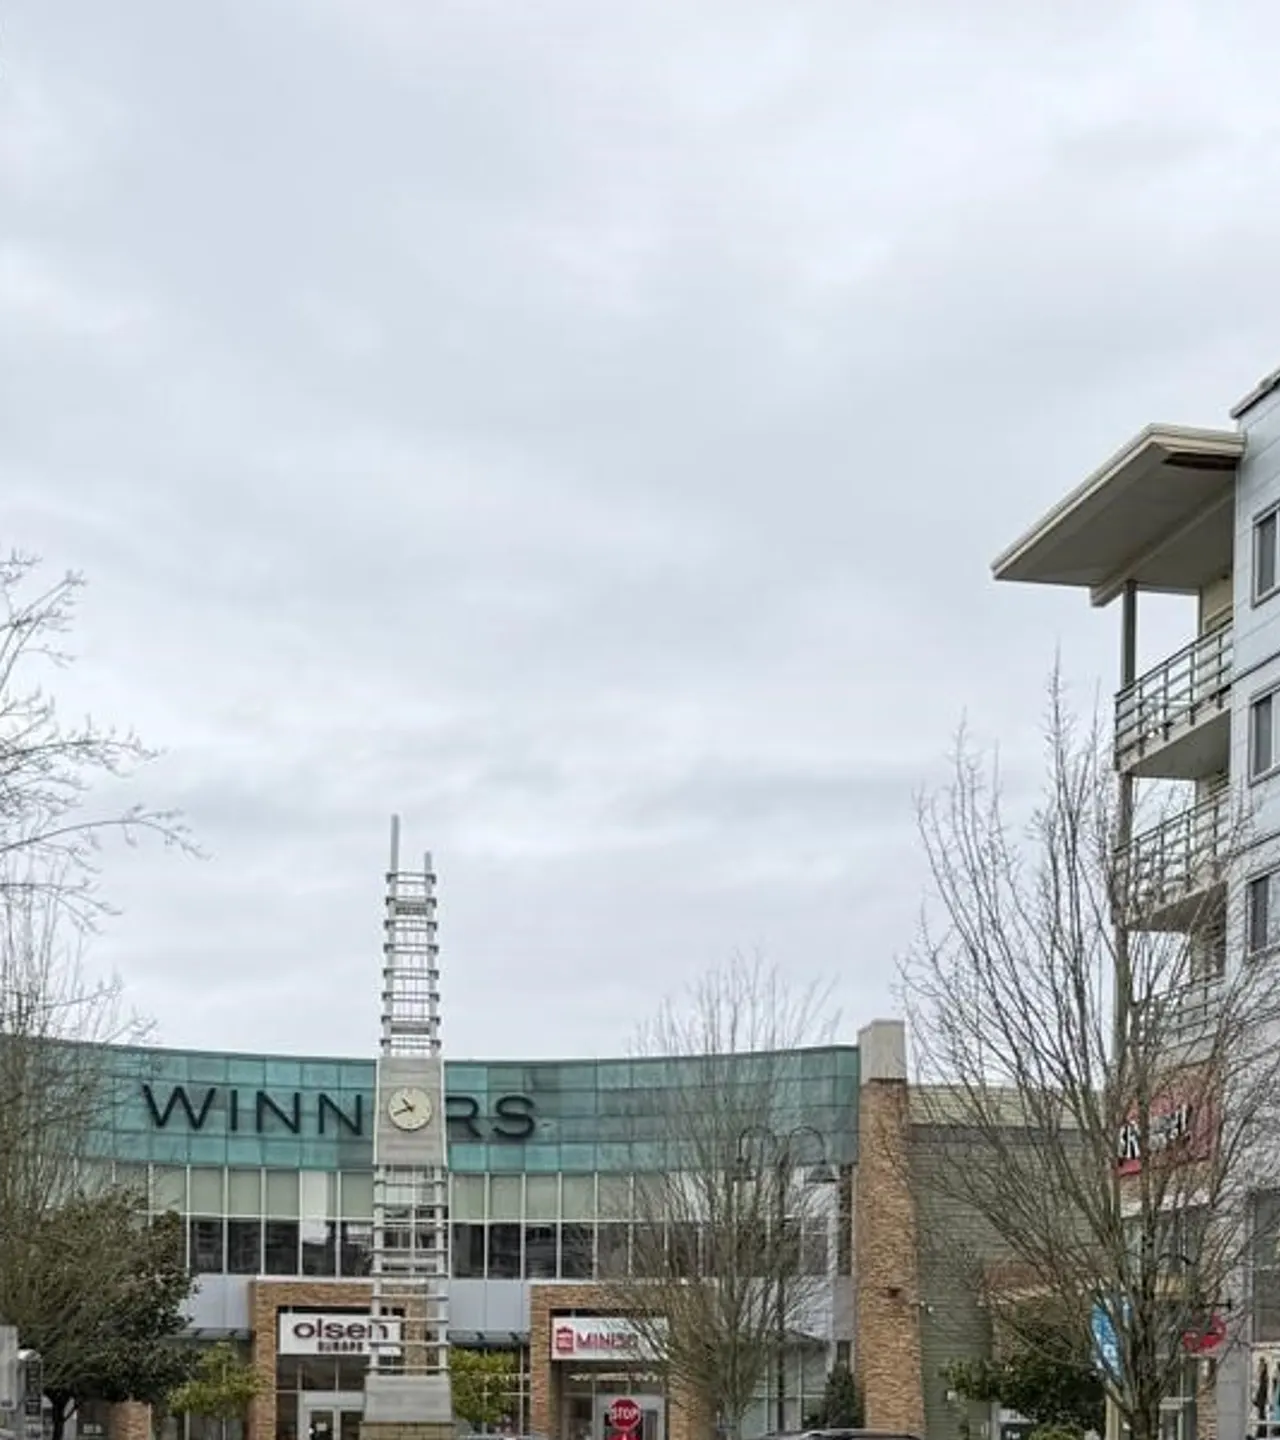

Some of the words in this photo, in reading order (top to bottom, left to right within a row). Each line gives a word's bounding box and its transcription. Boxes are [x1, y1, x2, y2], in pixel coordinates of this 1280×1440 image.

[142, 1084, 536, 1139] WINNRS
[293, 1317, 389, 1340] olsen
[611, 1406, 637, 1420] STOP
